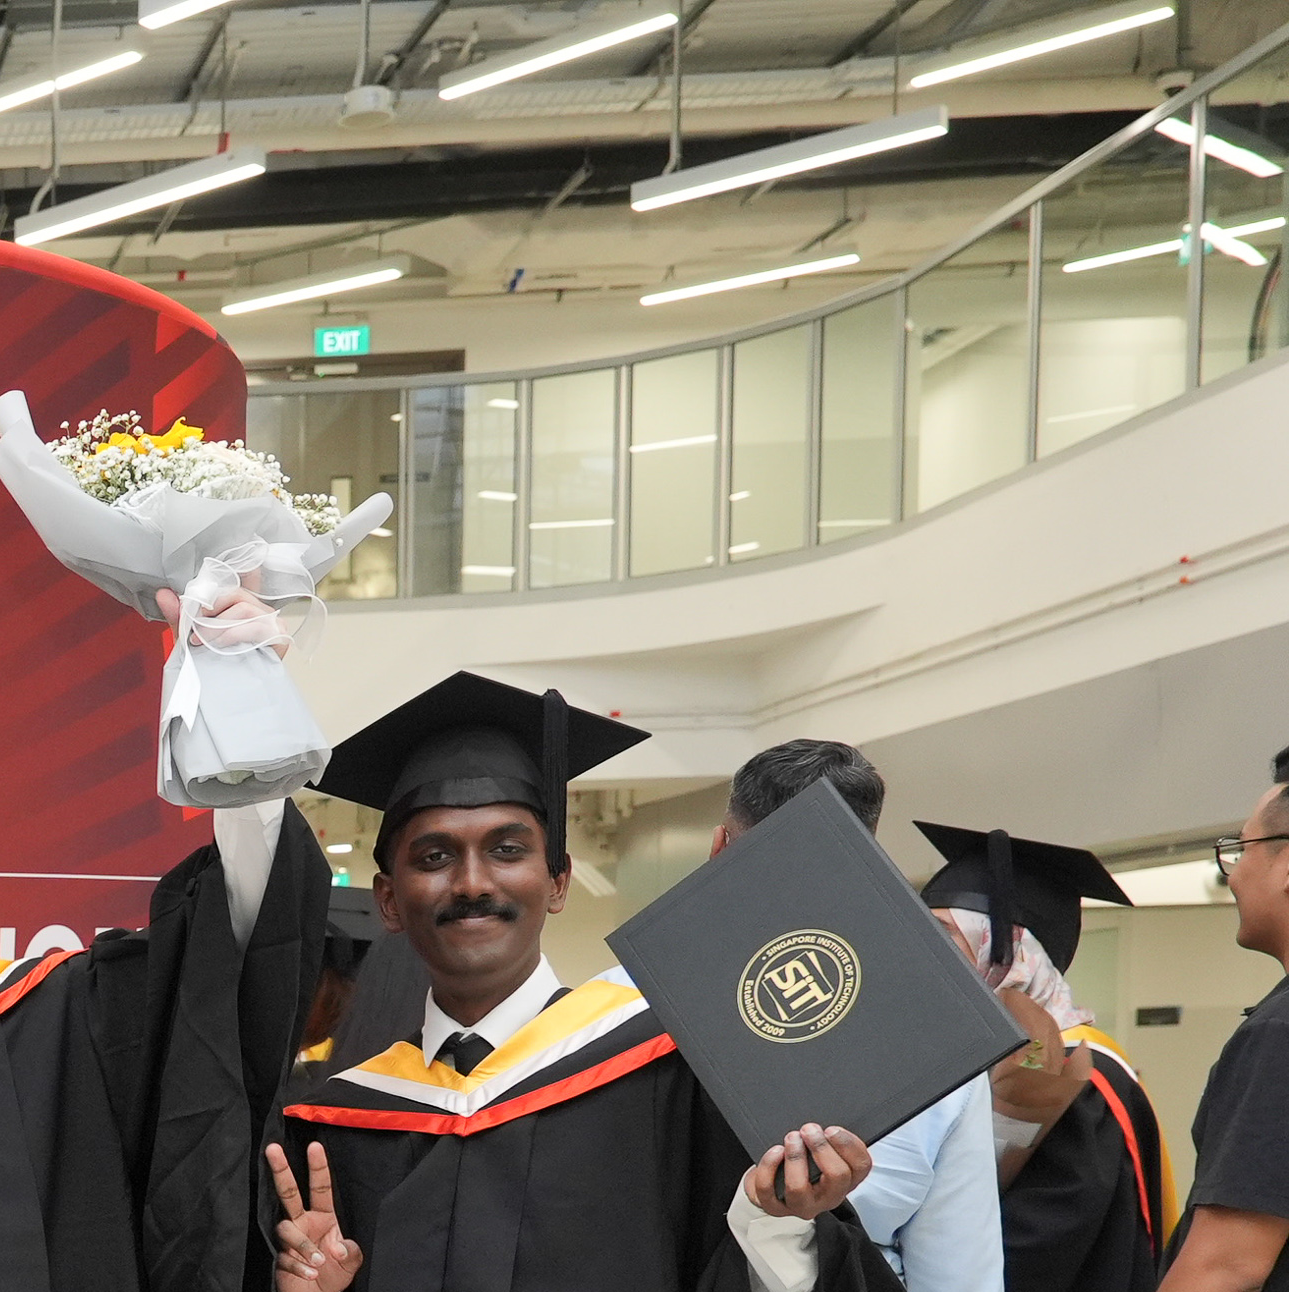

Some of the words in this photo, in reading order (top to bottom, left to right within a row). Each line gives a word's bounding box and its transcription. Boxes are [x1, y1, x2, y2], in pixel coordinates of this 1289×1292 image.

[324, 330, 361, 353] EXIT
[766, 935, 817, 957] SINGAPORE
[816, 936, 851, 967] INSTITUTE
[844, 964, 854, 977] OF
[744, 979, 765, 1027] Established
[761, 1023, 786, 1037] 2009
[816, 976, 854, 1030] TECHNOLOGY
